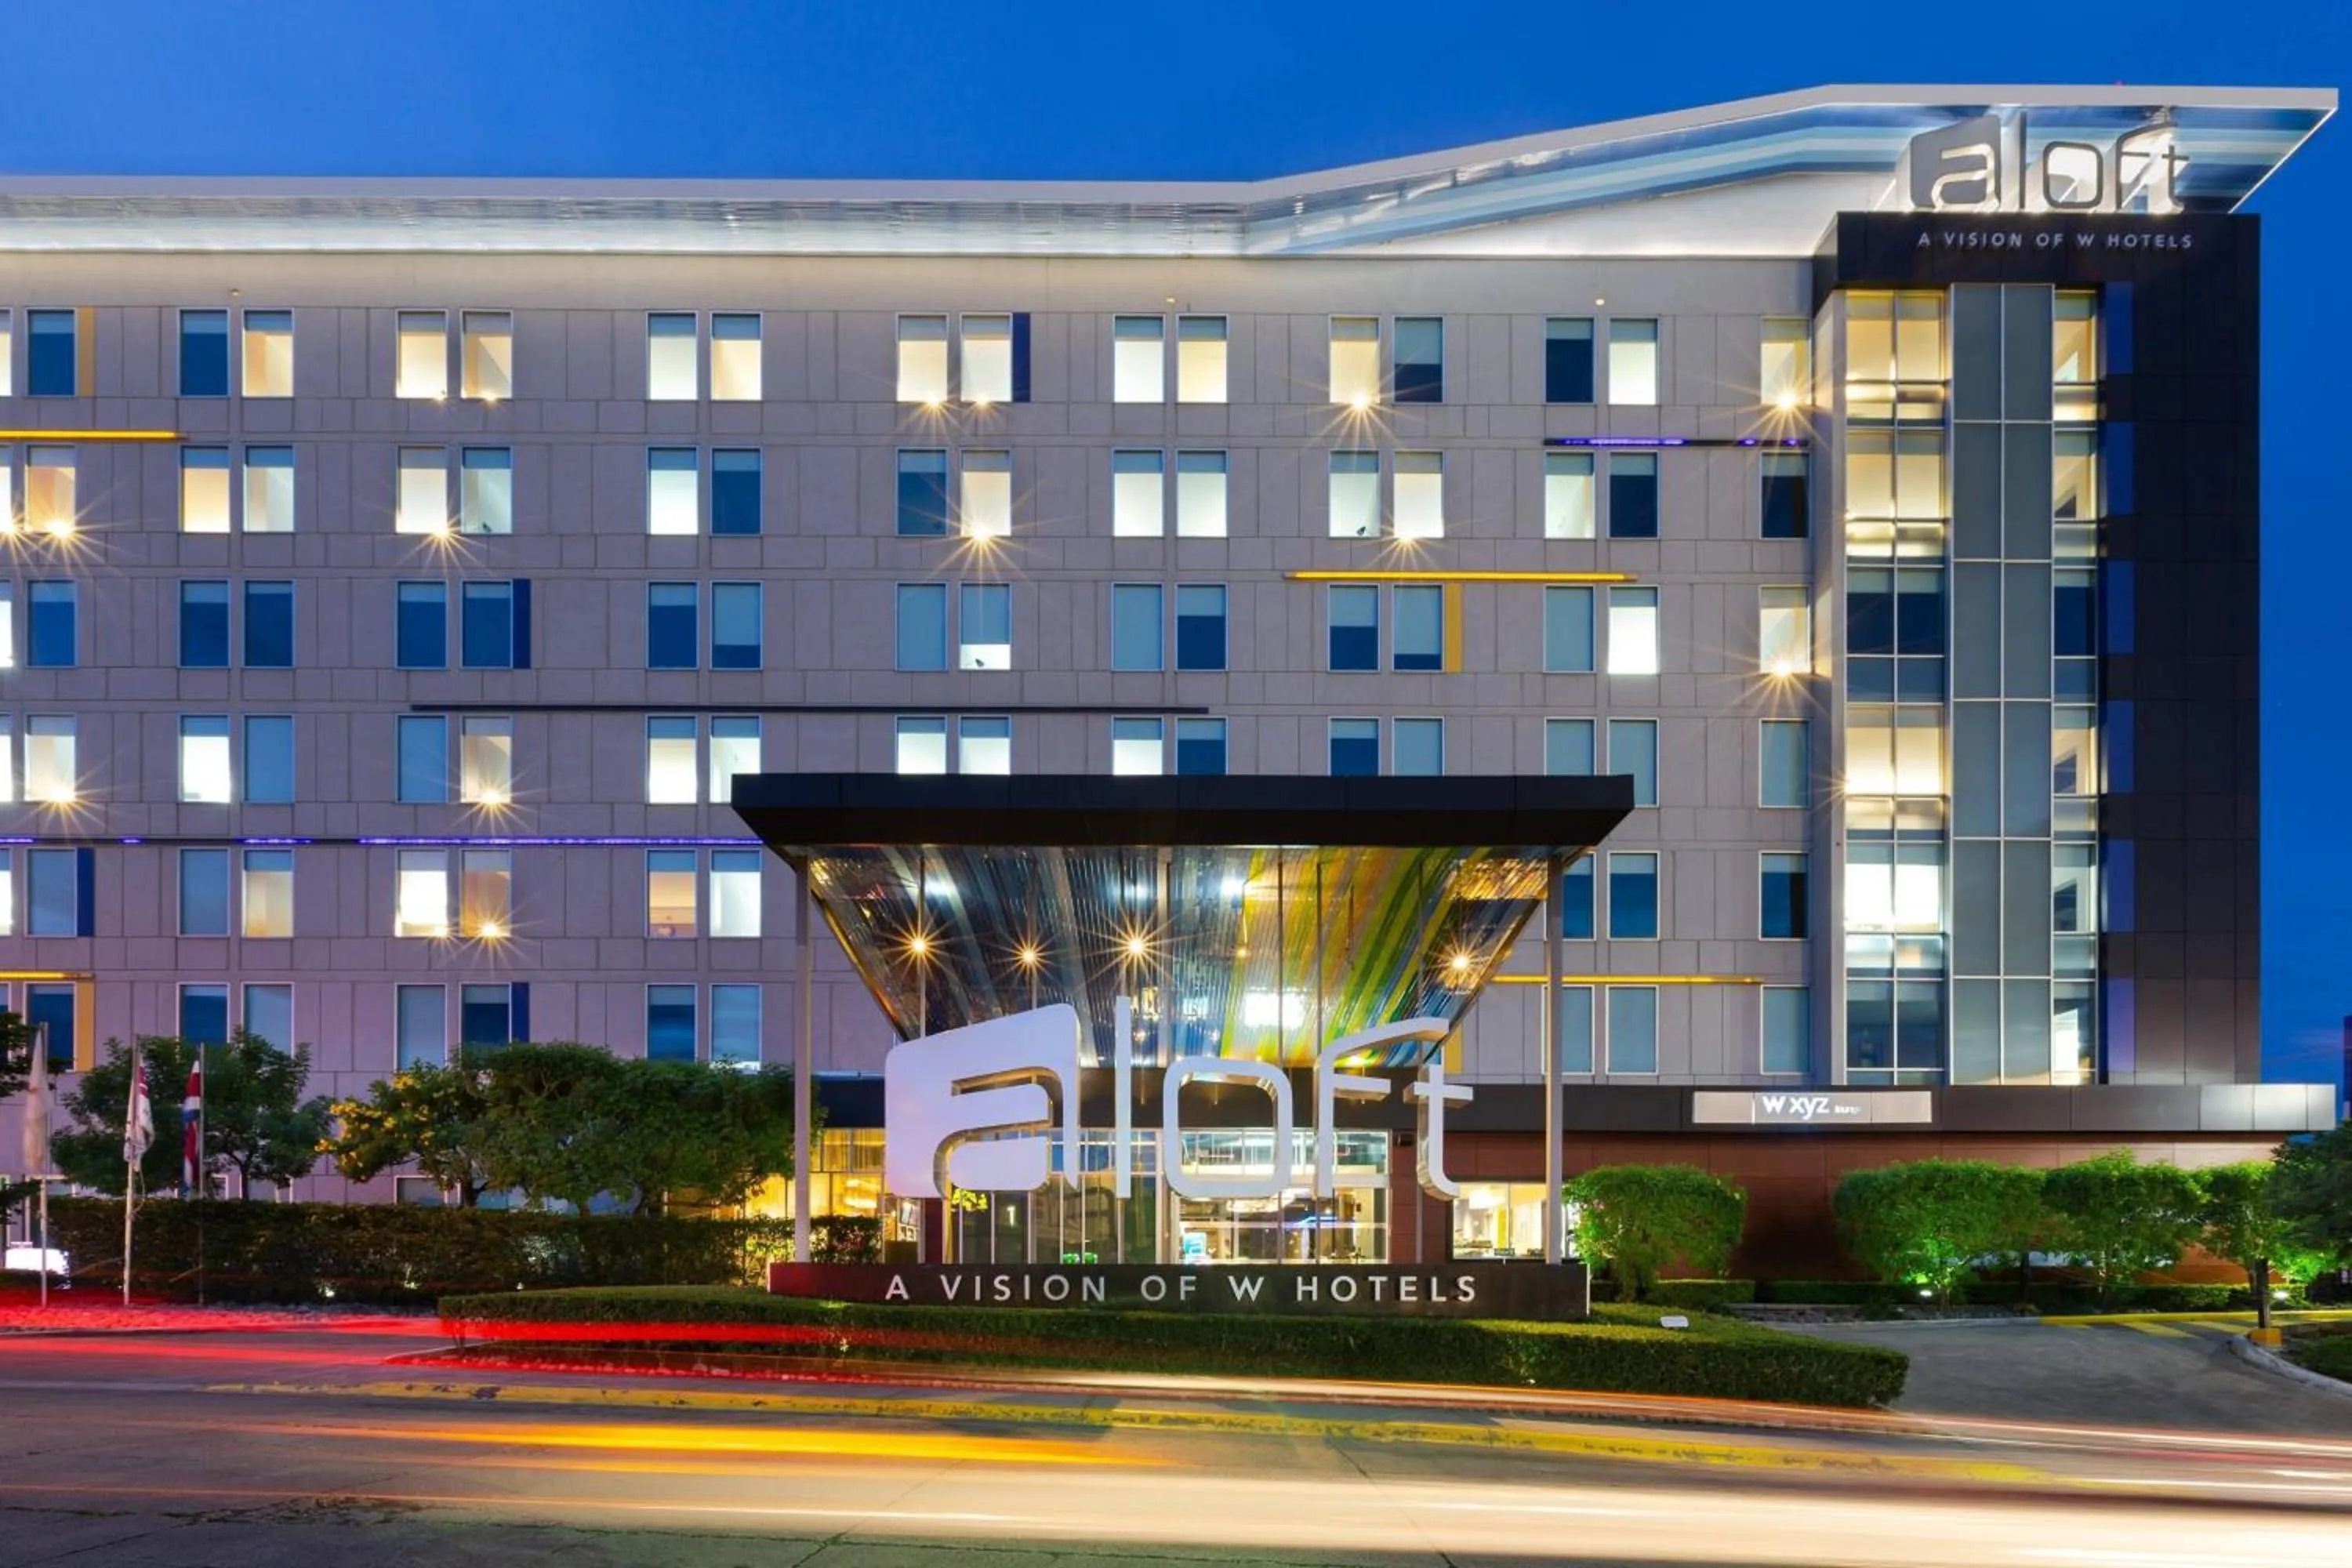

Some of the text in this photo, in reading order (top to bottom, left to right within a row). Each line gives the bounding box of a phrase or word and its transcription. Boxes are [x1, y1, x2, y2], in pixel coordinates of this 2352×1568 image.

[1910, 111, 2190, 209] aloft
[1918, 233, 2192, 249] A VISION OF W HOTELS
[886, 996, 1472, 1201] aloft
[884, 1273, 1476, 1302] A VISION OF W HOTELS
